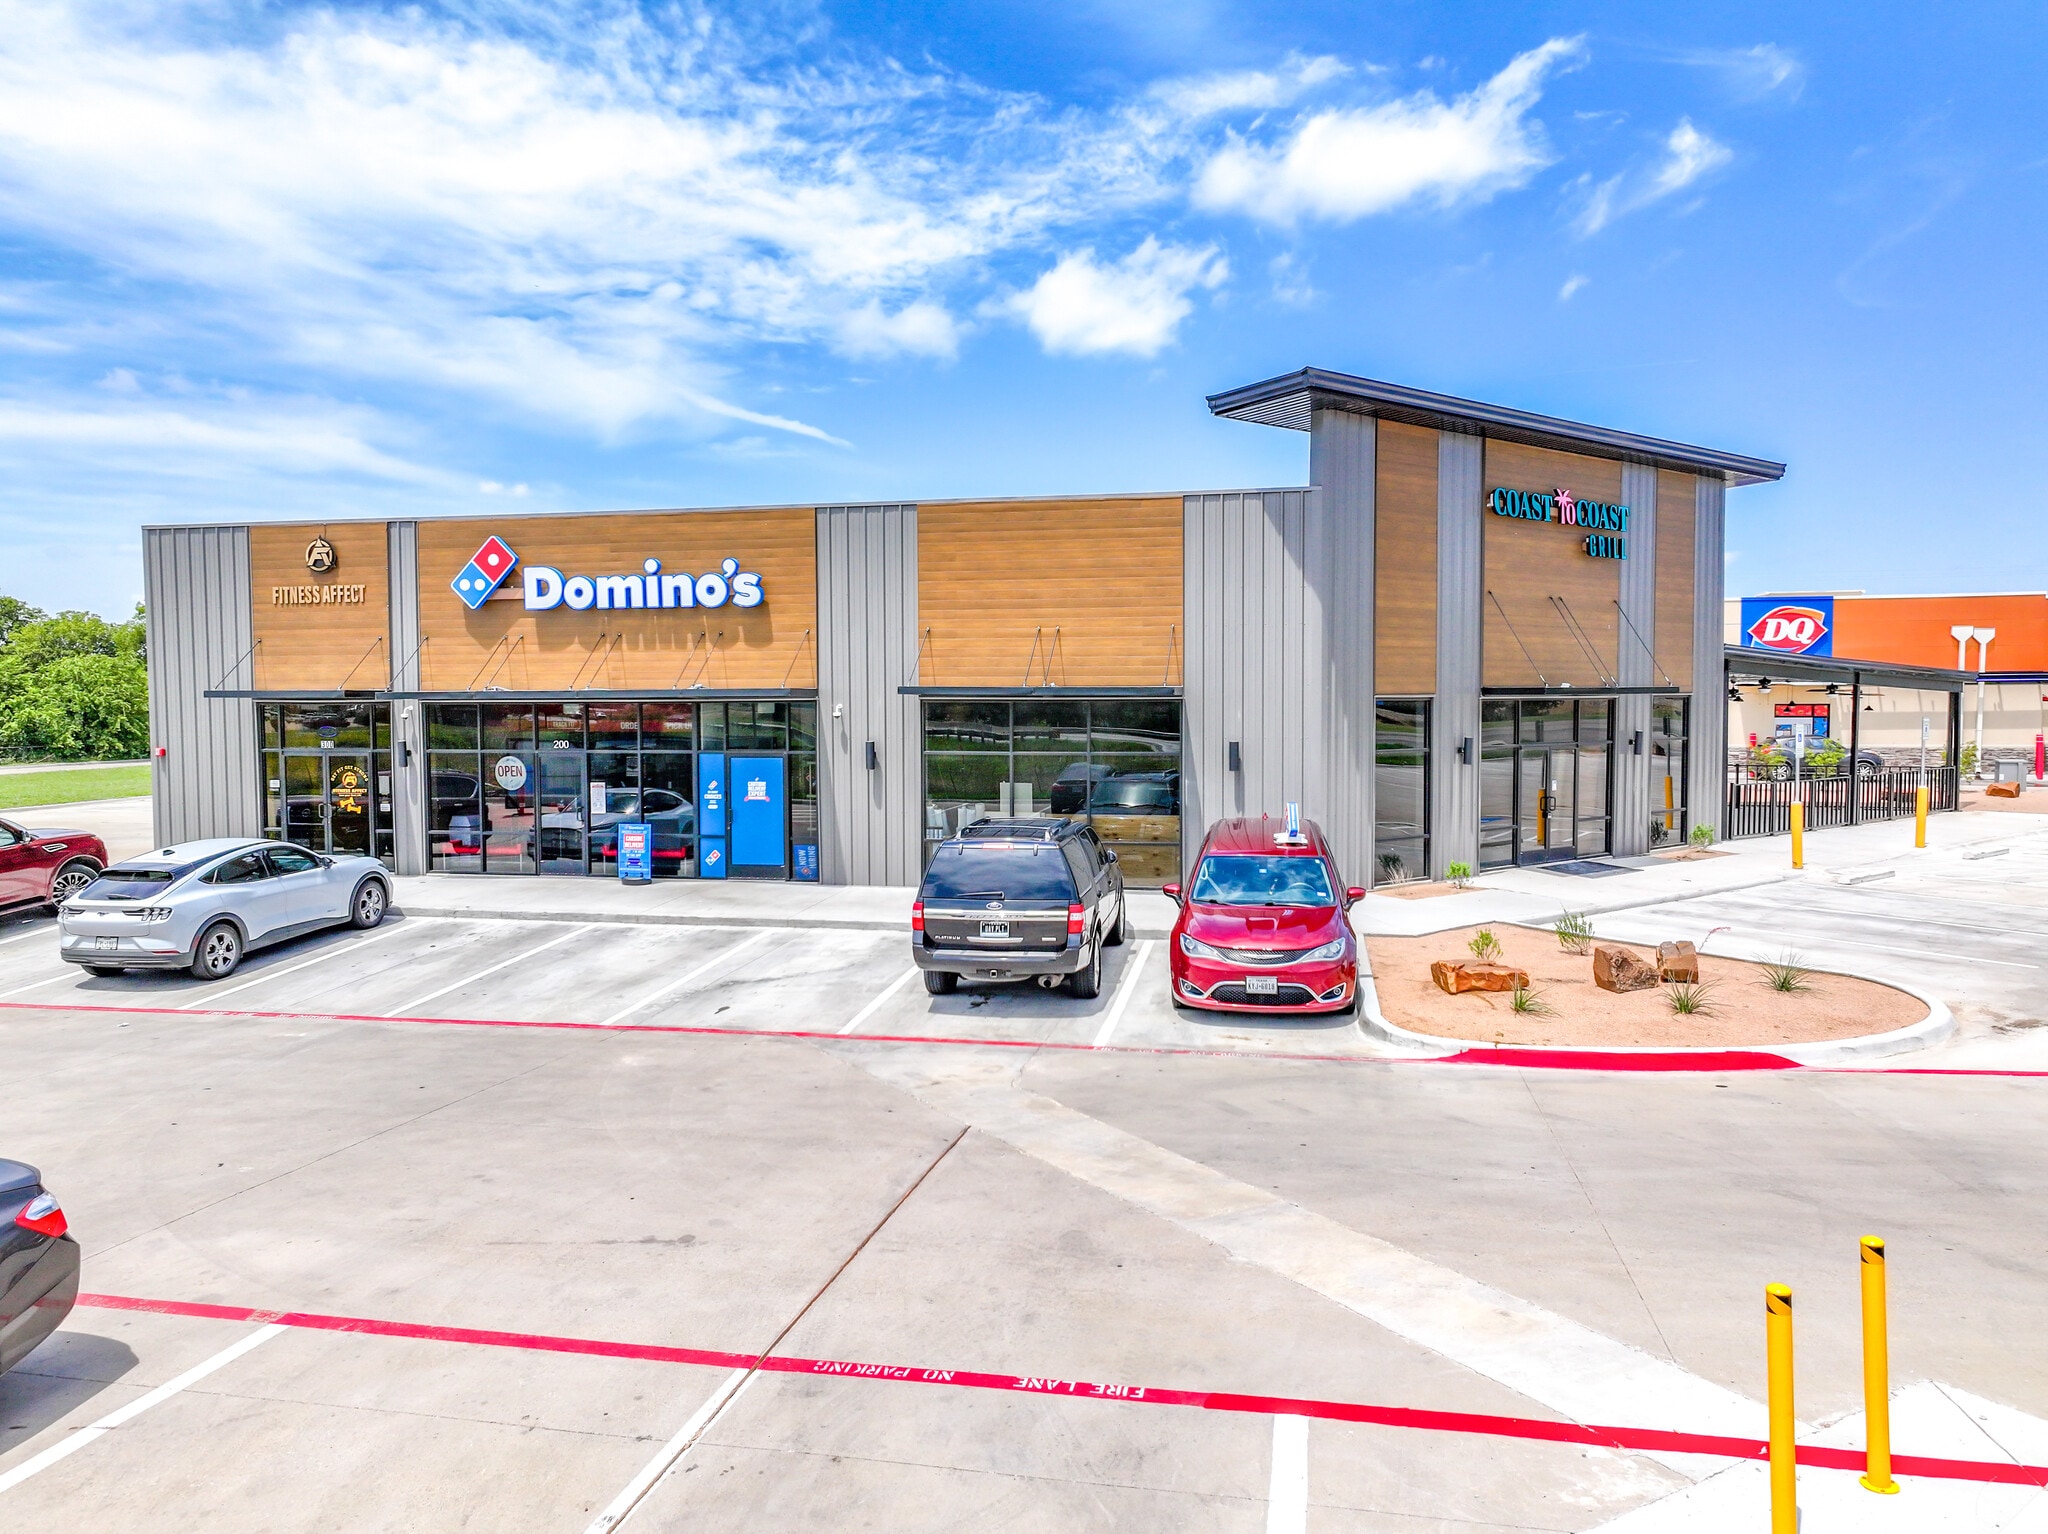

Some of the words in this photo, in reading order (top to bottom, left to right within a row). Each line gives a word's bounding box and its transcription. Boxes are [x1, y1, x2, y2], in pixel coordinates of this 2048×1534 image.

[1493, 487, 1553, 522] COAST
[1576, 499, 1630, 532] COAST
[1589, 534, 1627, 560] GRILL
[523, 558, 764, 611] Domino's
[272, 585, 321, 604] FITNESS
[322, 584, 366, 603] AFFECT
[1762, 617, 1815, 645] DQ
[553, 740, 569, 749] 200
[497, 765, 523, 777] OPEN
[798, 849, 807, 865] NOW
[808, 845, 817, 869] HIRING
[813, 1361, 911, 1378] PARKING
[922, 1368, 955, 1381] NO
[1013, 1377, 1077, 1393] LANE
[1089, 1382, 1146, 1399] FIRE
